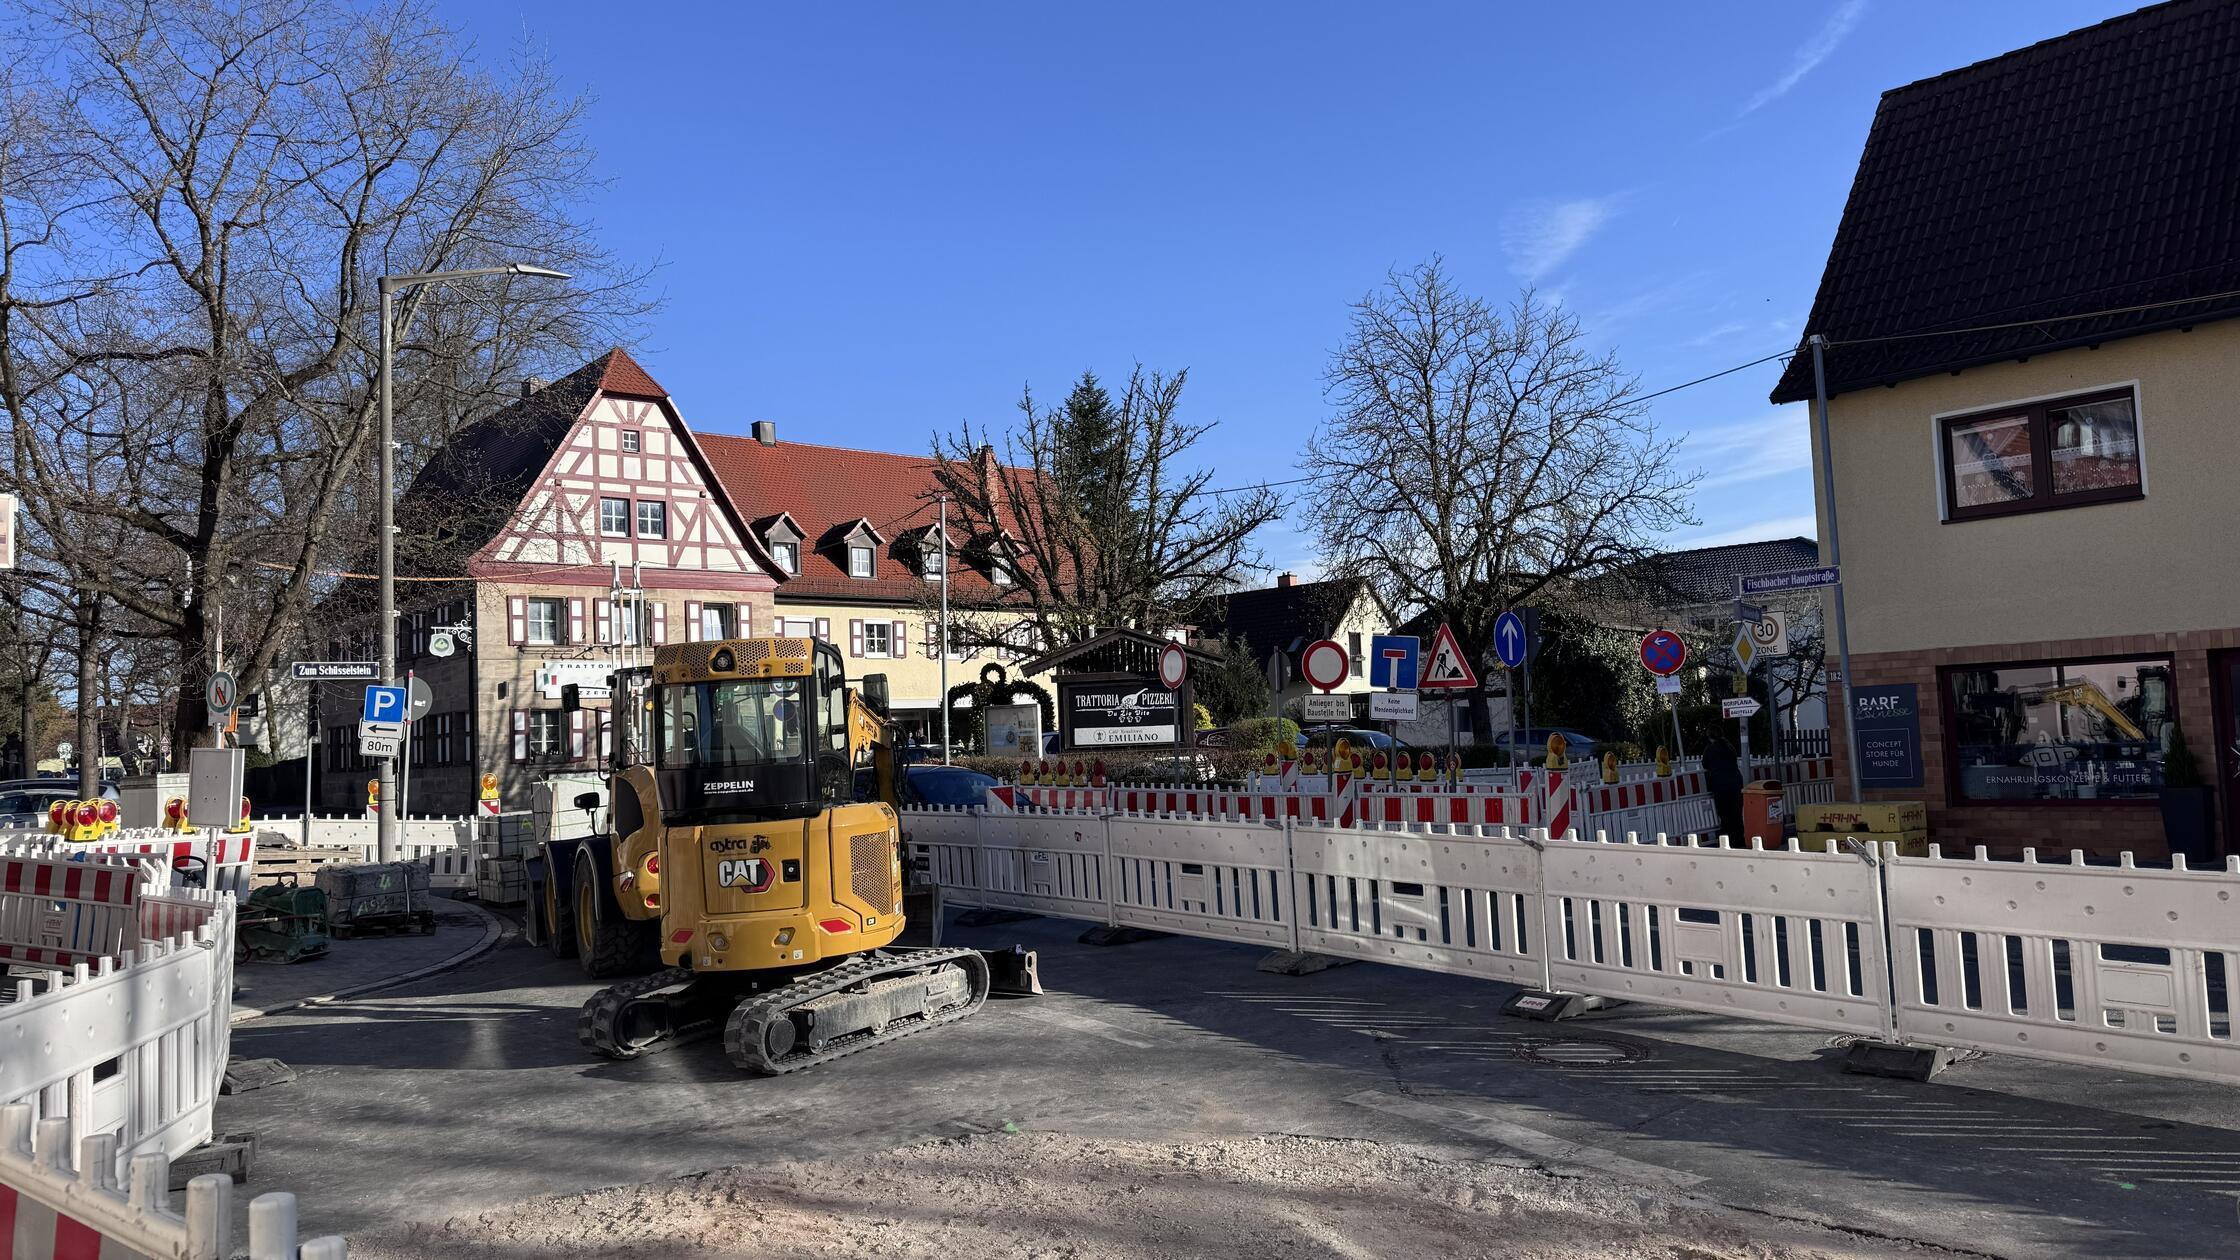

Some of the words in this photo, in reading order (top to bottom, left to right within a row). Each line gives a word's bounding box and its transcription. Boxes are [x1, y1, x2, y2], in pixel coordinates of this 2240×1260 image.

[1747, 577, 1789, 589] Fischbacher
[1791, 570, 1835, 585] Hauptstraße
[1757, 623, 1773, 637] 30
[1756, 645, 1778, 655] ZONE
[299, 665, 317, 676] Zum
[373, 690, 396, 718] P
[1075, 694, 1120, 707] TRATTORIA
[1308, 699, 1334, 708] Anlieger
[1336, 699, 1345, 707] bis
[1859, 696, 1900, 711] BARF
[1307, 709, 1335, 717] Baustelle
[1336, 709, 1347, 717] frei
[1108, 733, 1159, 742] EMILIANO
[367, 741, 393, 752] 80m
[1866, 740, 1902, 749] CONCEPT
[1865, 750, 1889, 758] STORE
[703, 780, 754, 791] ZEPPELIN
[719, 860, 760, 887] CAT
